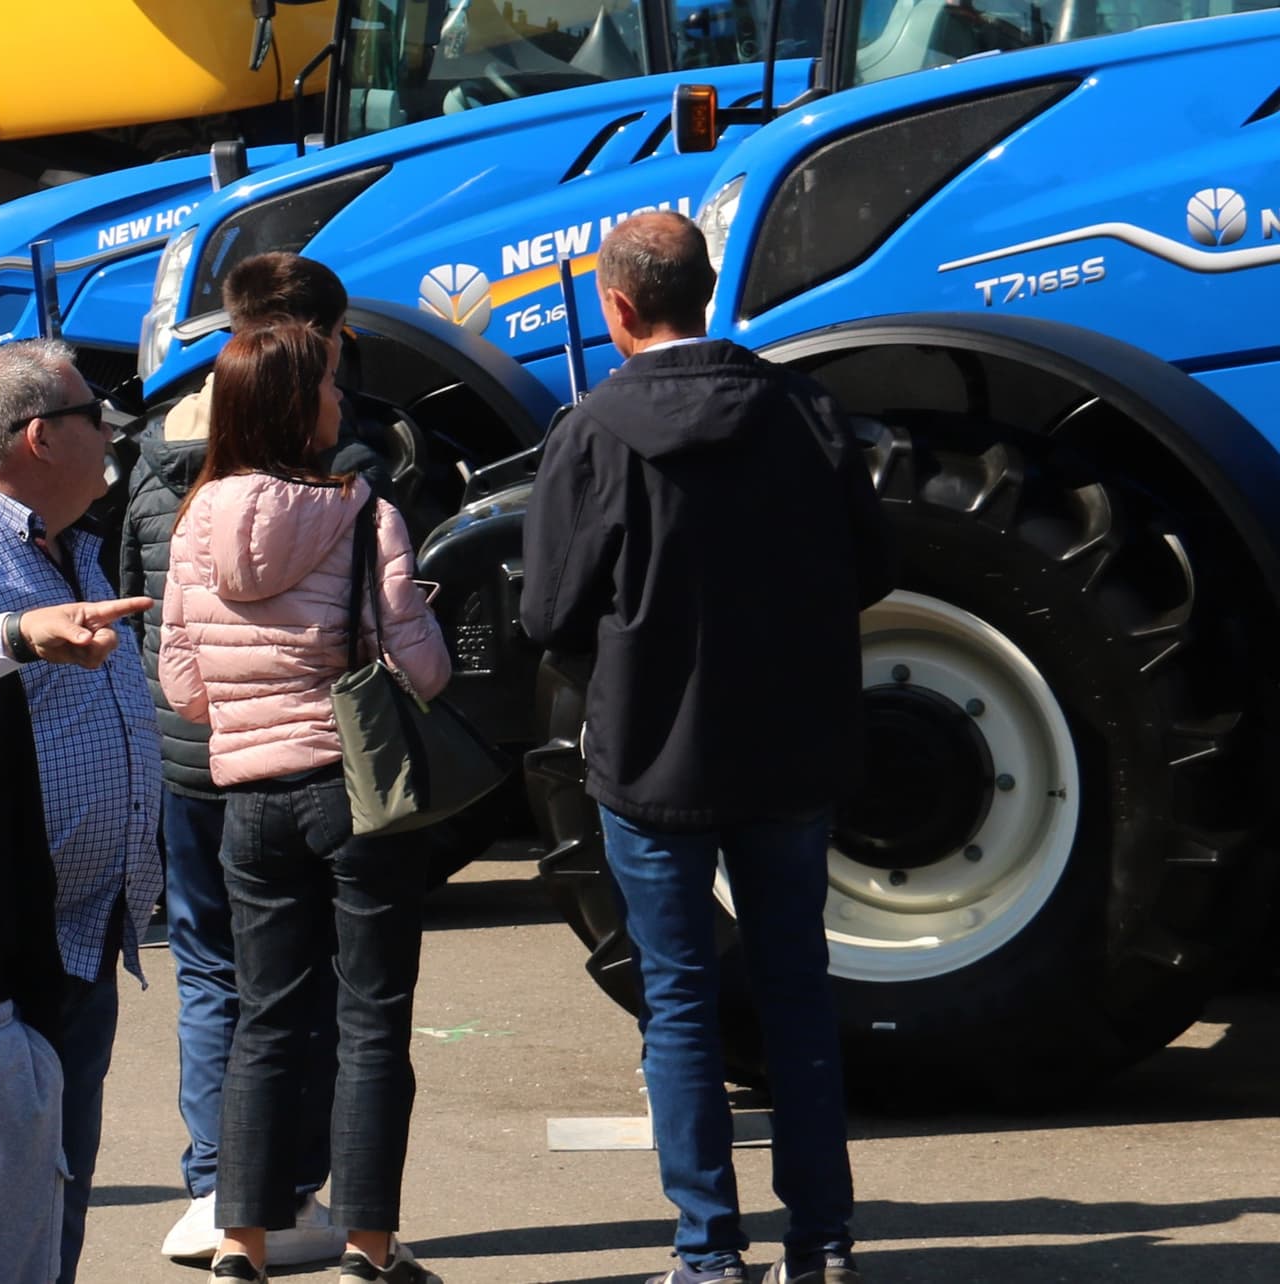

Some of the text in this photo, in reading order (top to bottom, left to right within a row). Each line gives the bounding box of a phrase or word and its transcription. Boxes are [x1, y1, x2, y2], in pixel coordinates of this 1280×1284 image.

[98, 215, 152, 250] NEW
[502, 222, 593, 275] NEW
[974, 256, 1105, 307] T7.165S
[505, 303, 568, 339] T6.16
